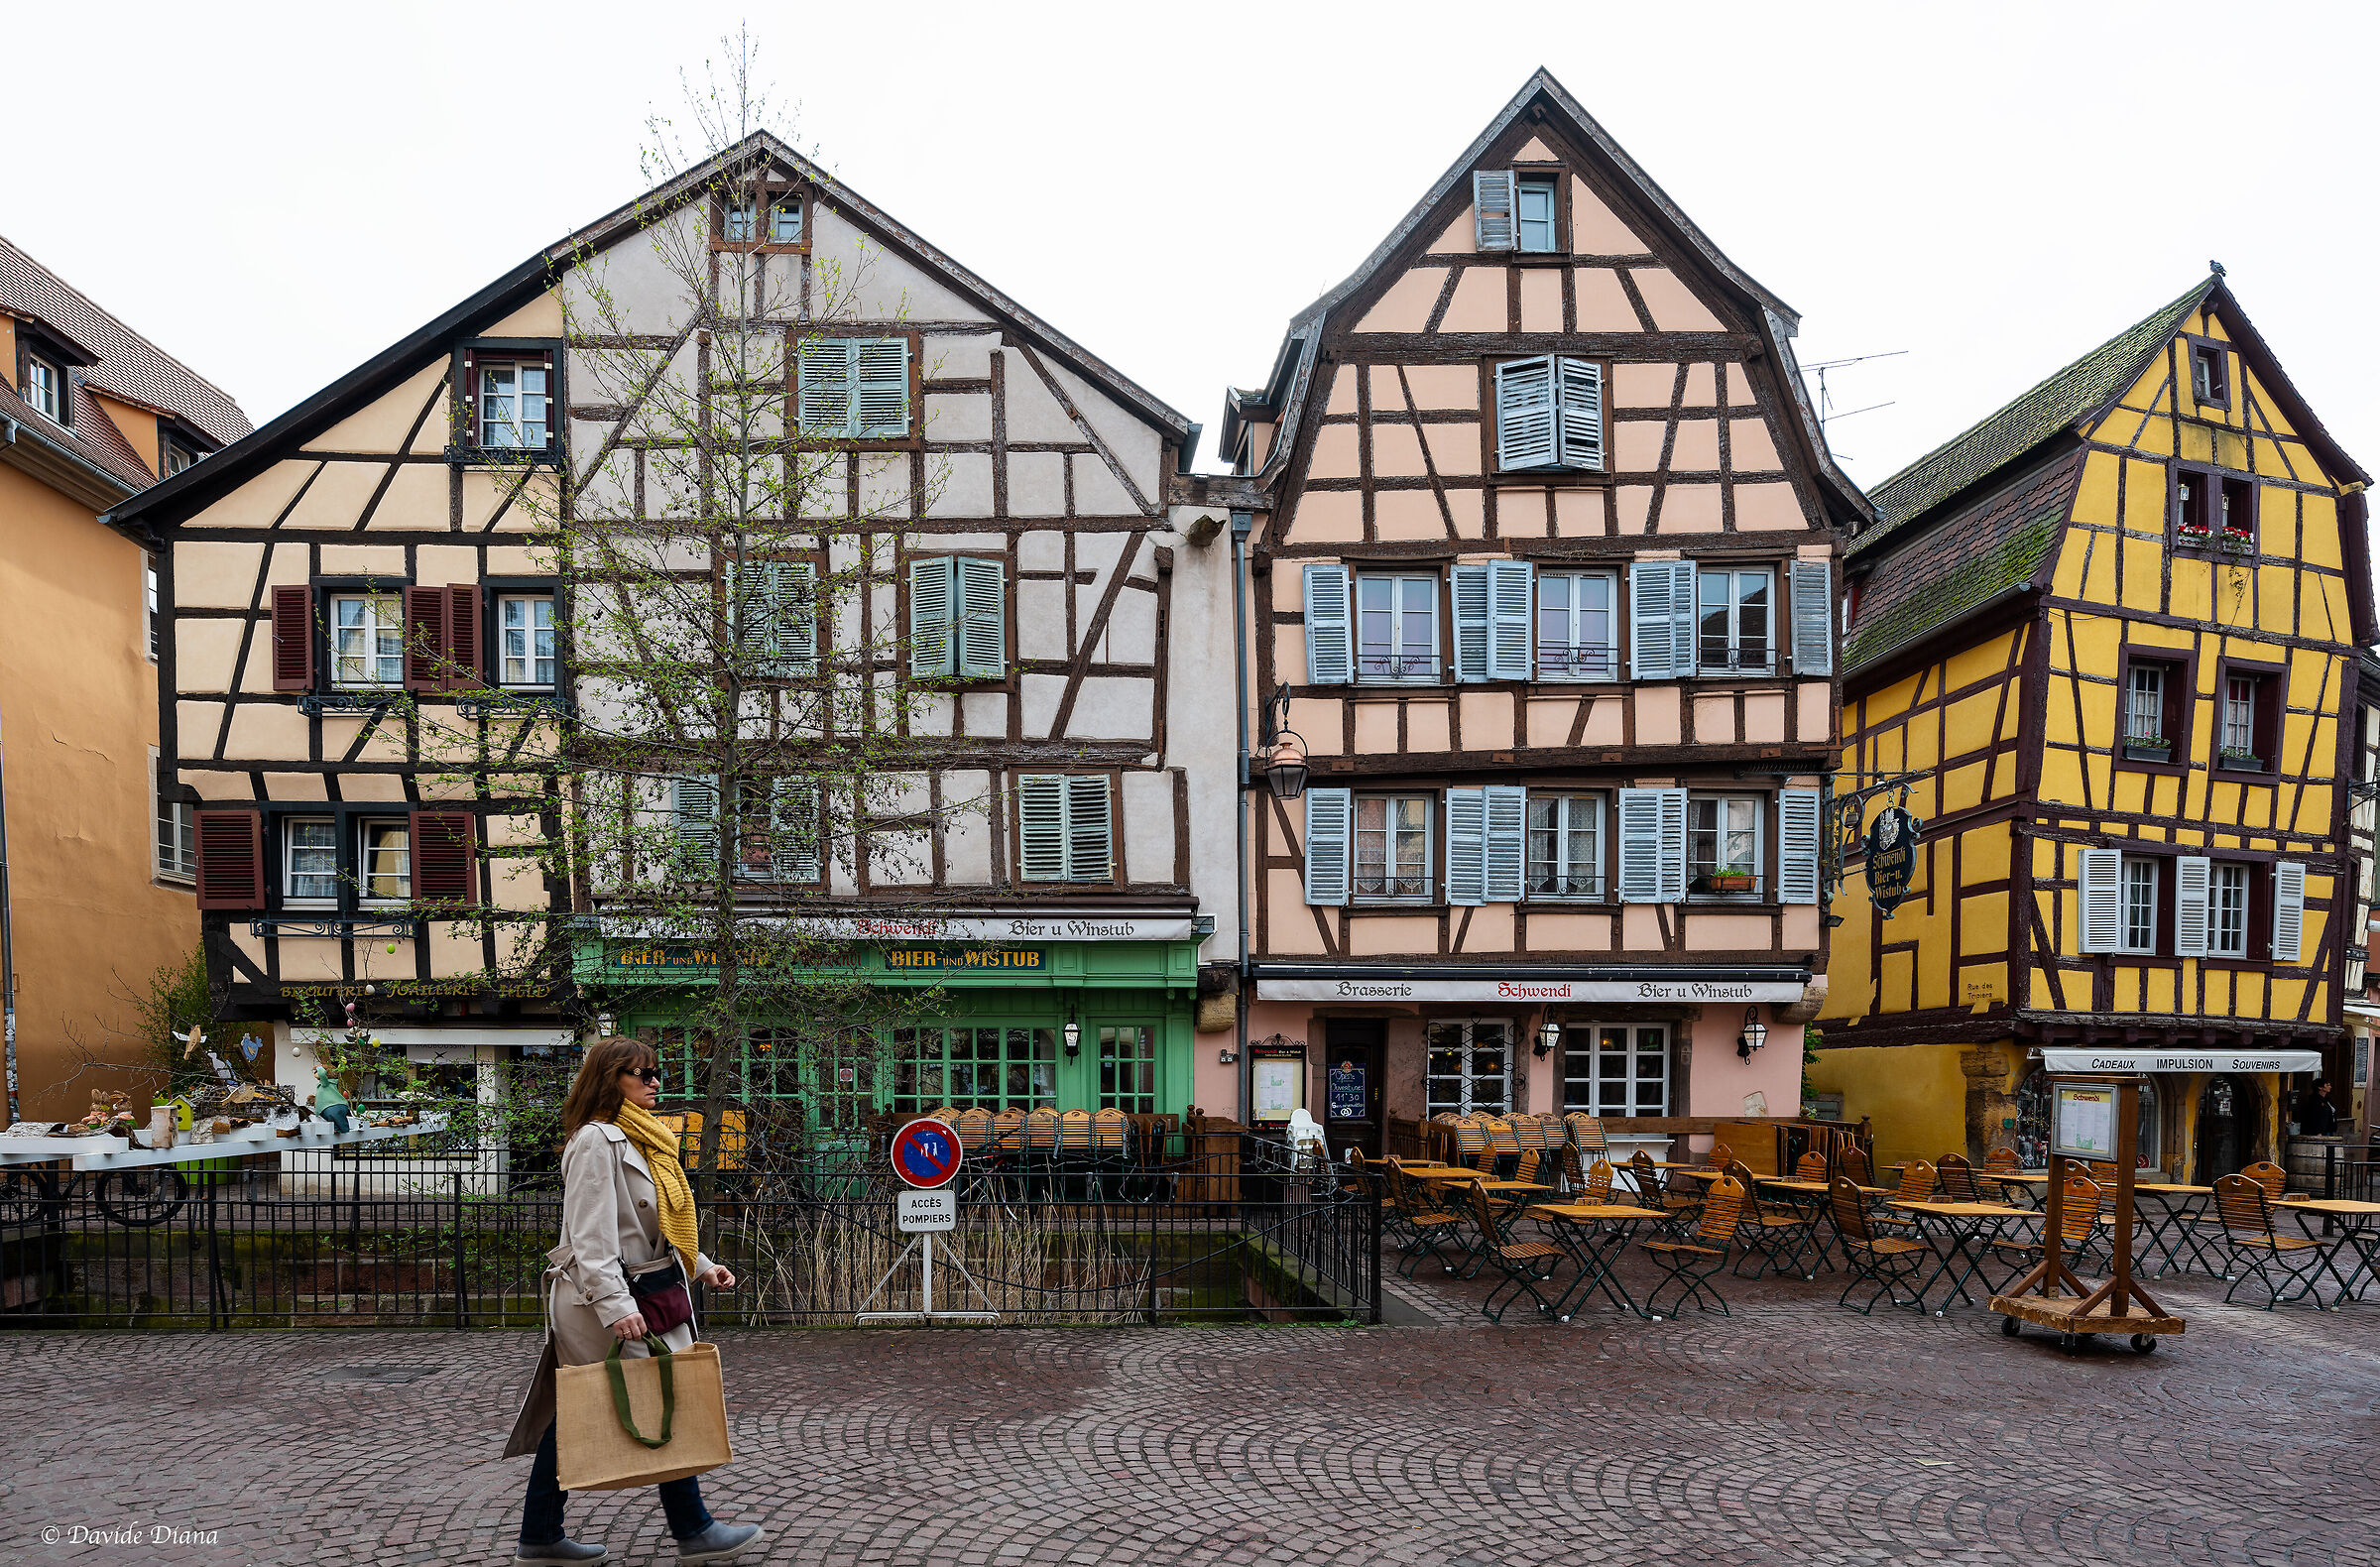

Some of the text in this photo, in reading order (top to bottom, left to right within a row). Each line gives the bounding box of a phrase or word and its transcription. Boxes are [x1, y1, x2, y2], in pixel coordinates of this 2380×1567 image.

[1873, 846, 1906, 870] Schwendi
[857, 918, 1135, 936] Schwendi Bier u Winstub
[964, 950, 1039, 968] WISTUB
[1336, 981, 1752, 1000] Brasserie Schwendi Bier u Winstub
[2091, 1058, 2281, 1070] CADEAUX IMPULSION SOUVENIRS
[911, 1197, 942, 1209] ACCÈS
[902, 1213, 952, 1224] POMPIERS
